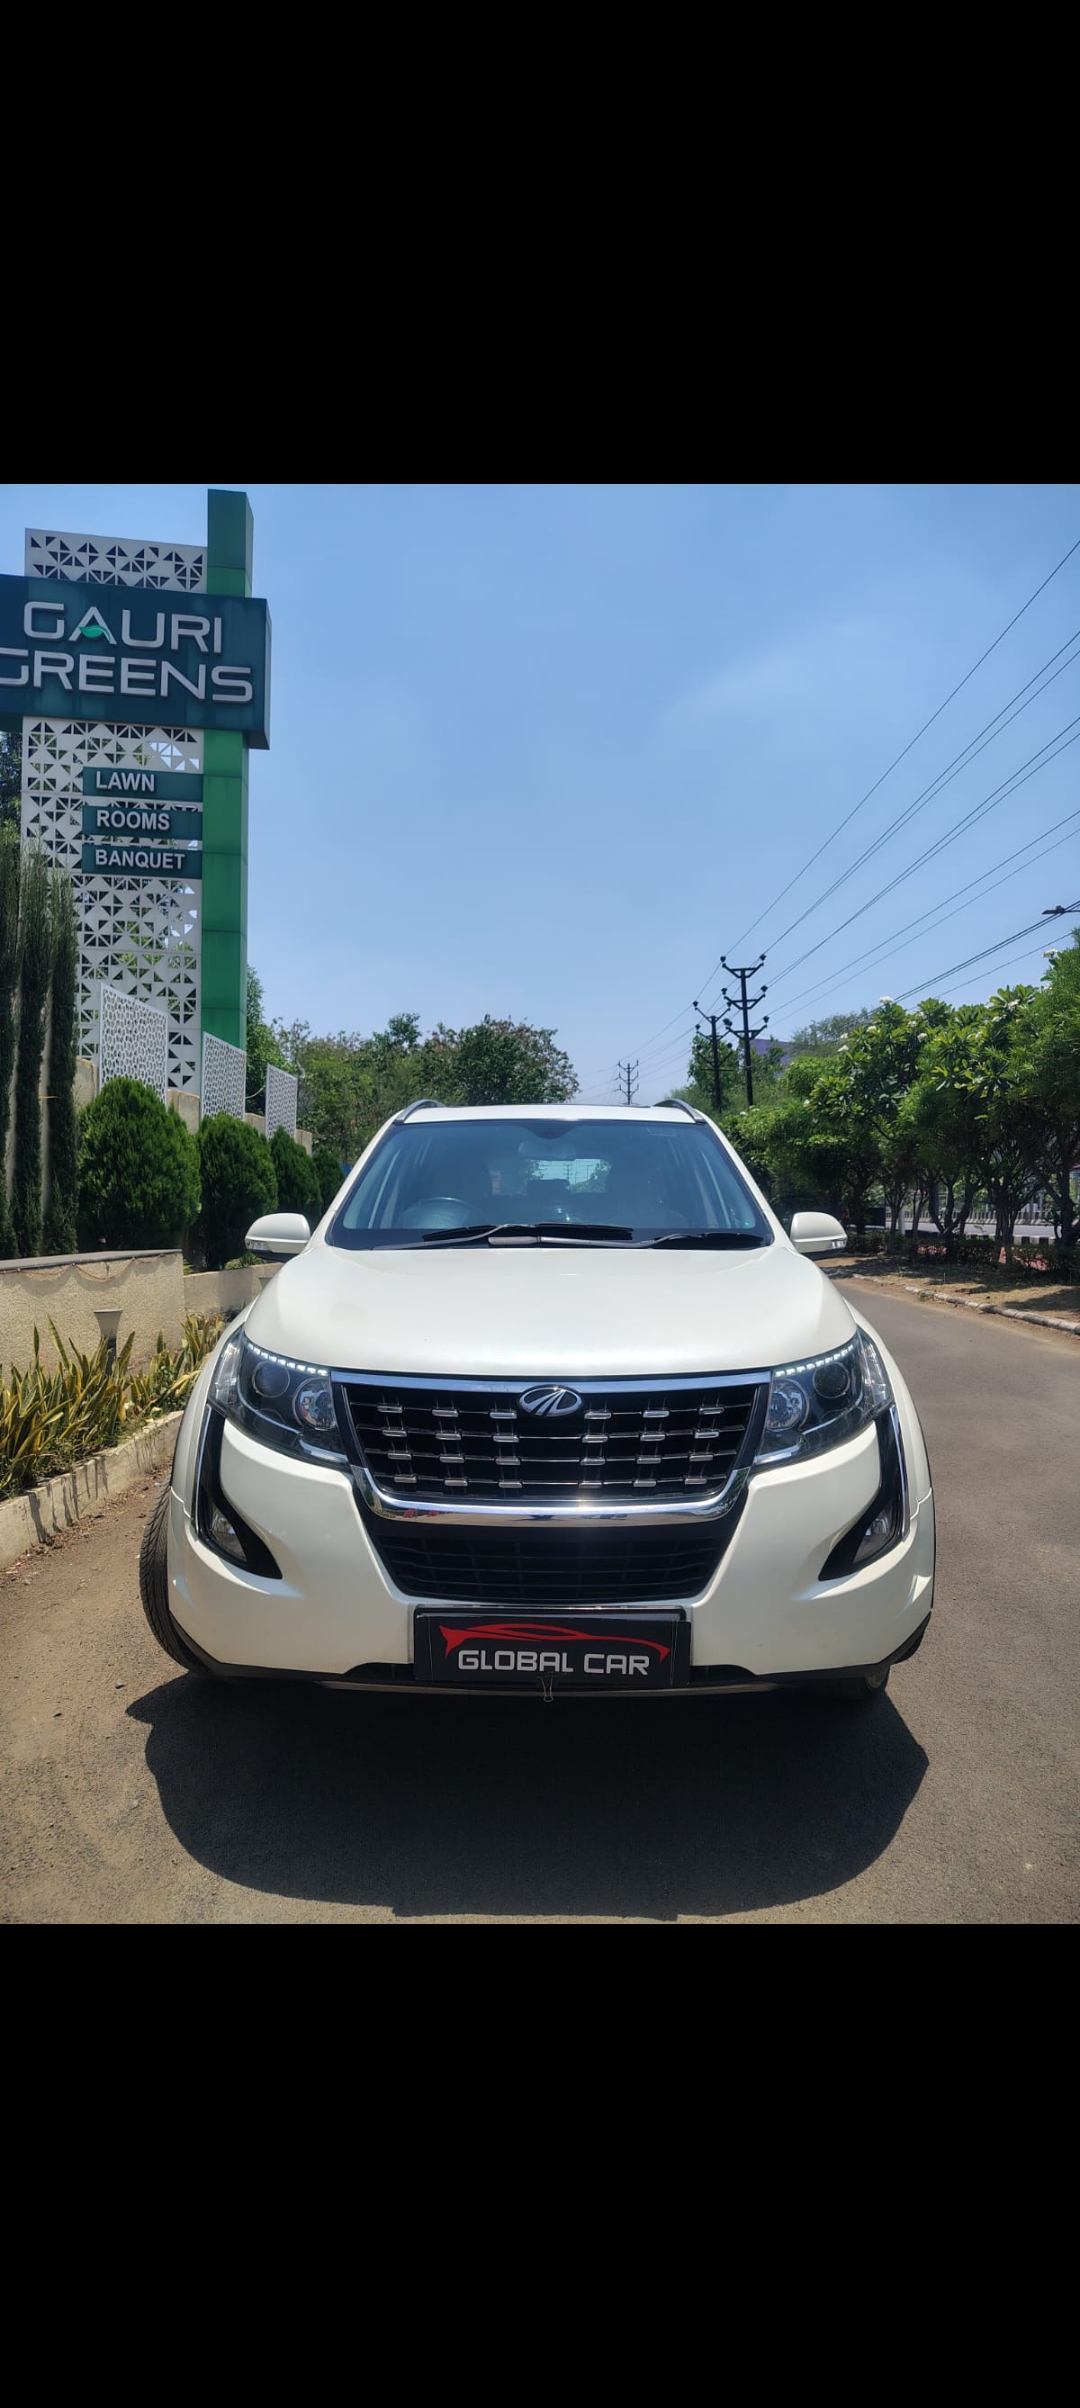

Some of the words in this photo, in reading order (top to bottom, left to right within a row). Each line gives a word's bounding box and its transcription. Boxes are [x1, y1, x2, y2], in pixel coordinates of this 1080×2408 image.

[24, 601, 222, 653] GAURI
[0, 648, 253, 702] GREENS
[96, 771, 155, 792] LAWN
[97, 810, 170, 831] ROOMS
[95, 850, 185, 870] BANQUET
[458, 1650, 574, 1673] GLOBAL
[583, 1653, 650, 1675] CAR
